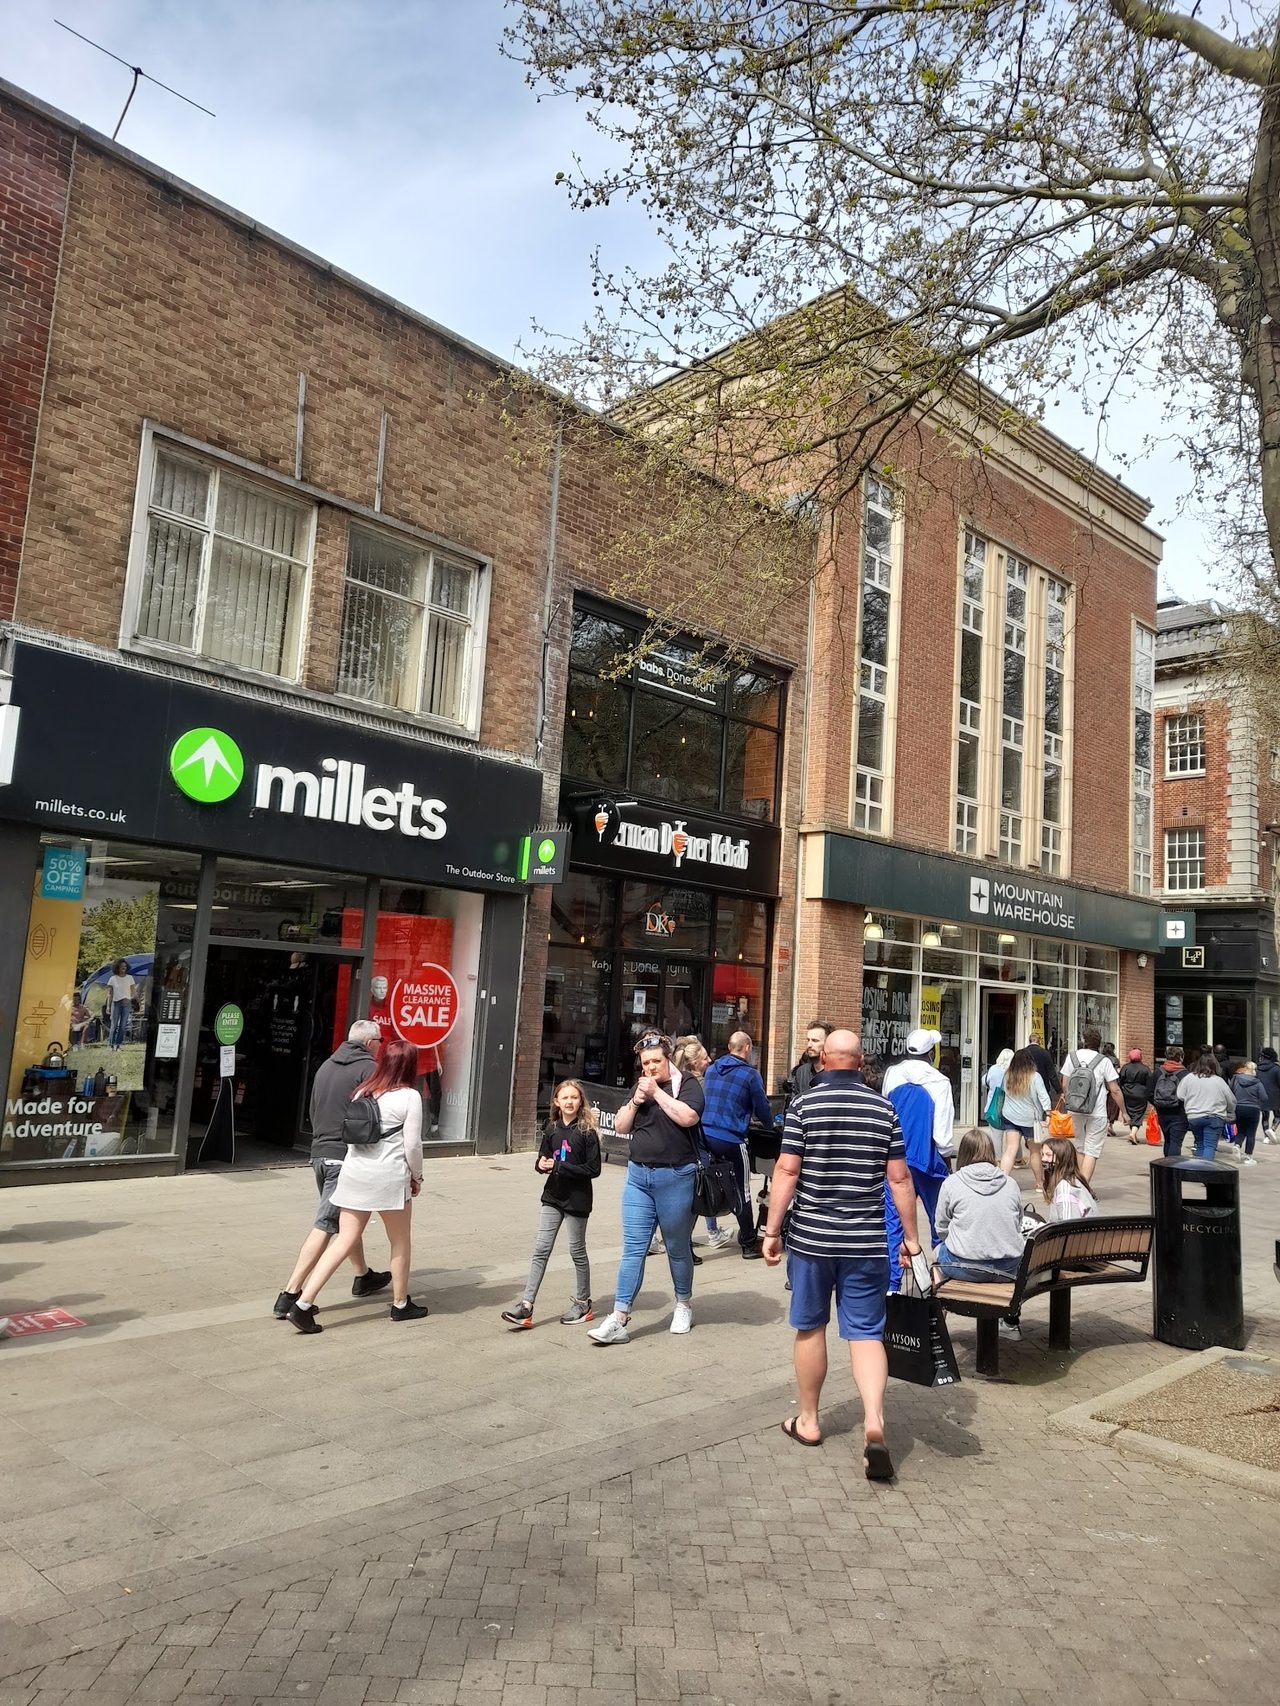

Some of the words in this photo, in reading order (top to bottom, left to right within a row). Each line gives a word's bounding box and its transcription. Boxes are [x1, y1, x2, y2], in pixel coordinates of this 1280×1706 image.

[256, 757, 449, 841] millets
[35, 798, 127, 824] millets.co.uk
[709, 832, 749, 871] Kebab
[48, 858, 82, 873] 50%
[445, 864, 460, 876] The
[461, 867, 496, 881] Outdoor
[495, 872, 516, 884] Store
[533, 865, 557, 876] millets
[46, 870, 81, 886] OFF
[44, 883, 80, 894] CAMPING
[993, 881, 1063, 909] MOUNTAIN
[993, 901, 1076, 930] WAREHOUSE
[403, 983, 452, 997] MASSIVE
[862, 986, 888, 1012] OSING
[401, 995, 451, 1006] CLEARANCE
[921, 1000, 940, 1013] OSING
[399, 1004, 450, 1028] SALE
[4, 1096, 63, 1116] Made
[67, 1096, 96, 1115] for
[2, 1120, 103, 1139] Adventure
